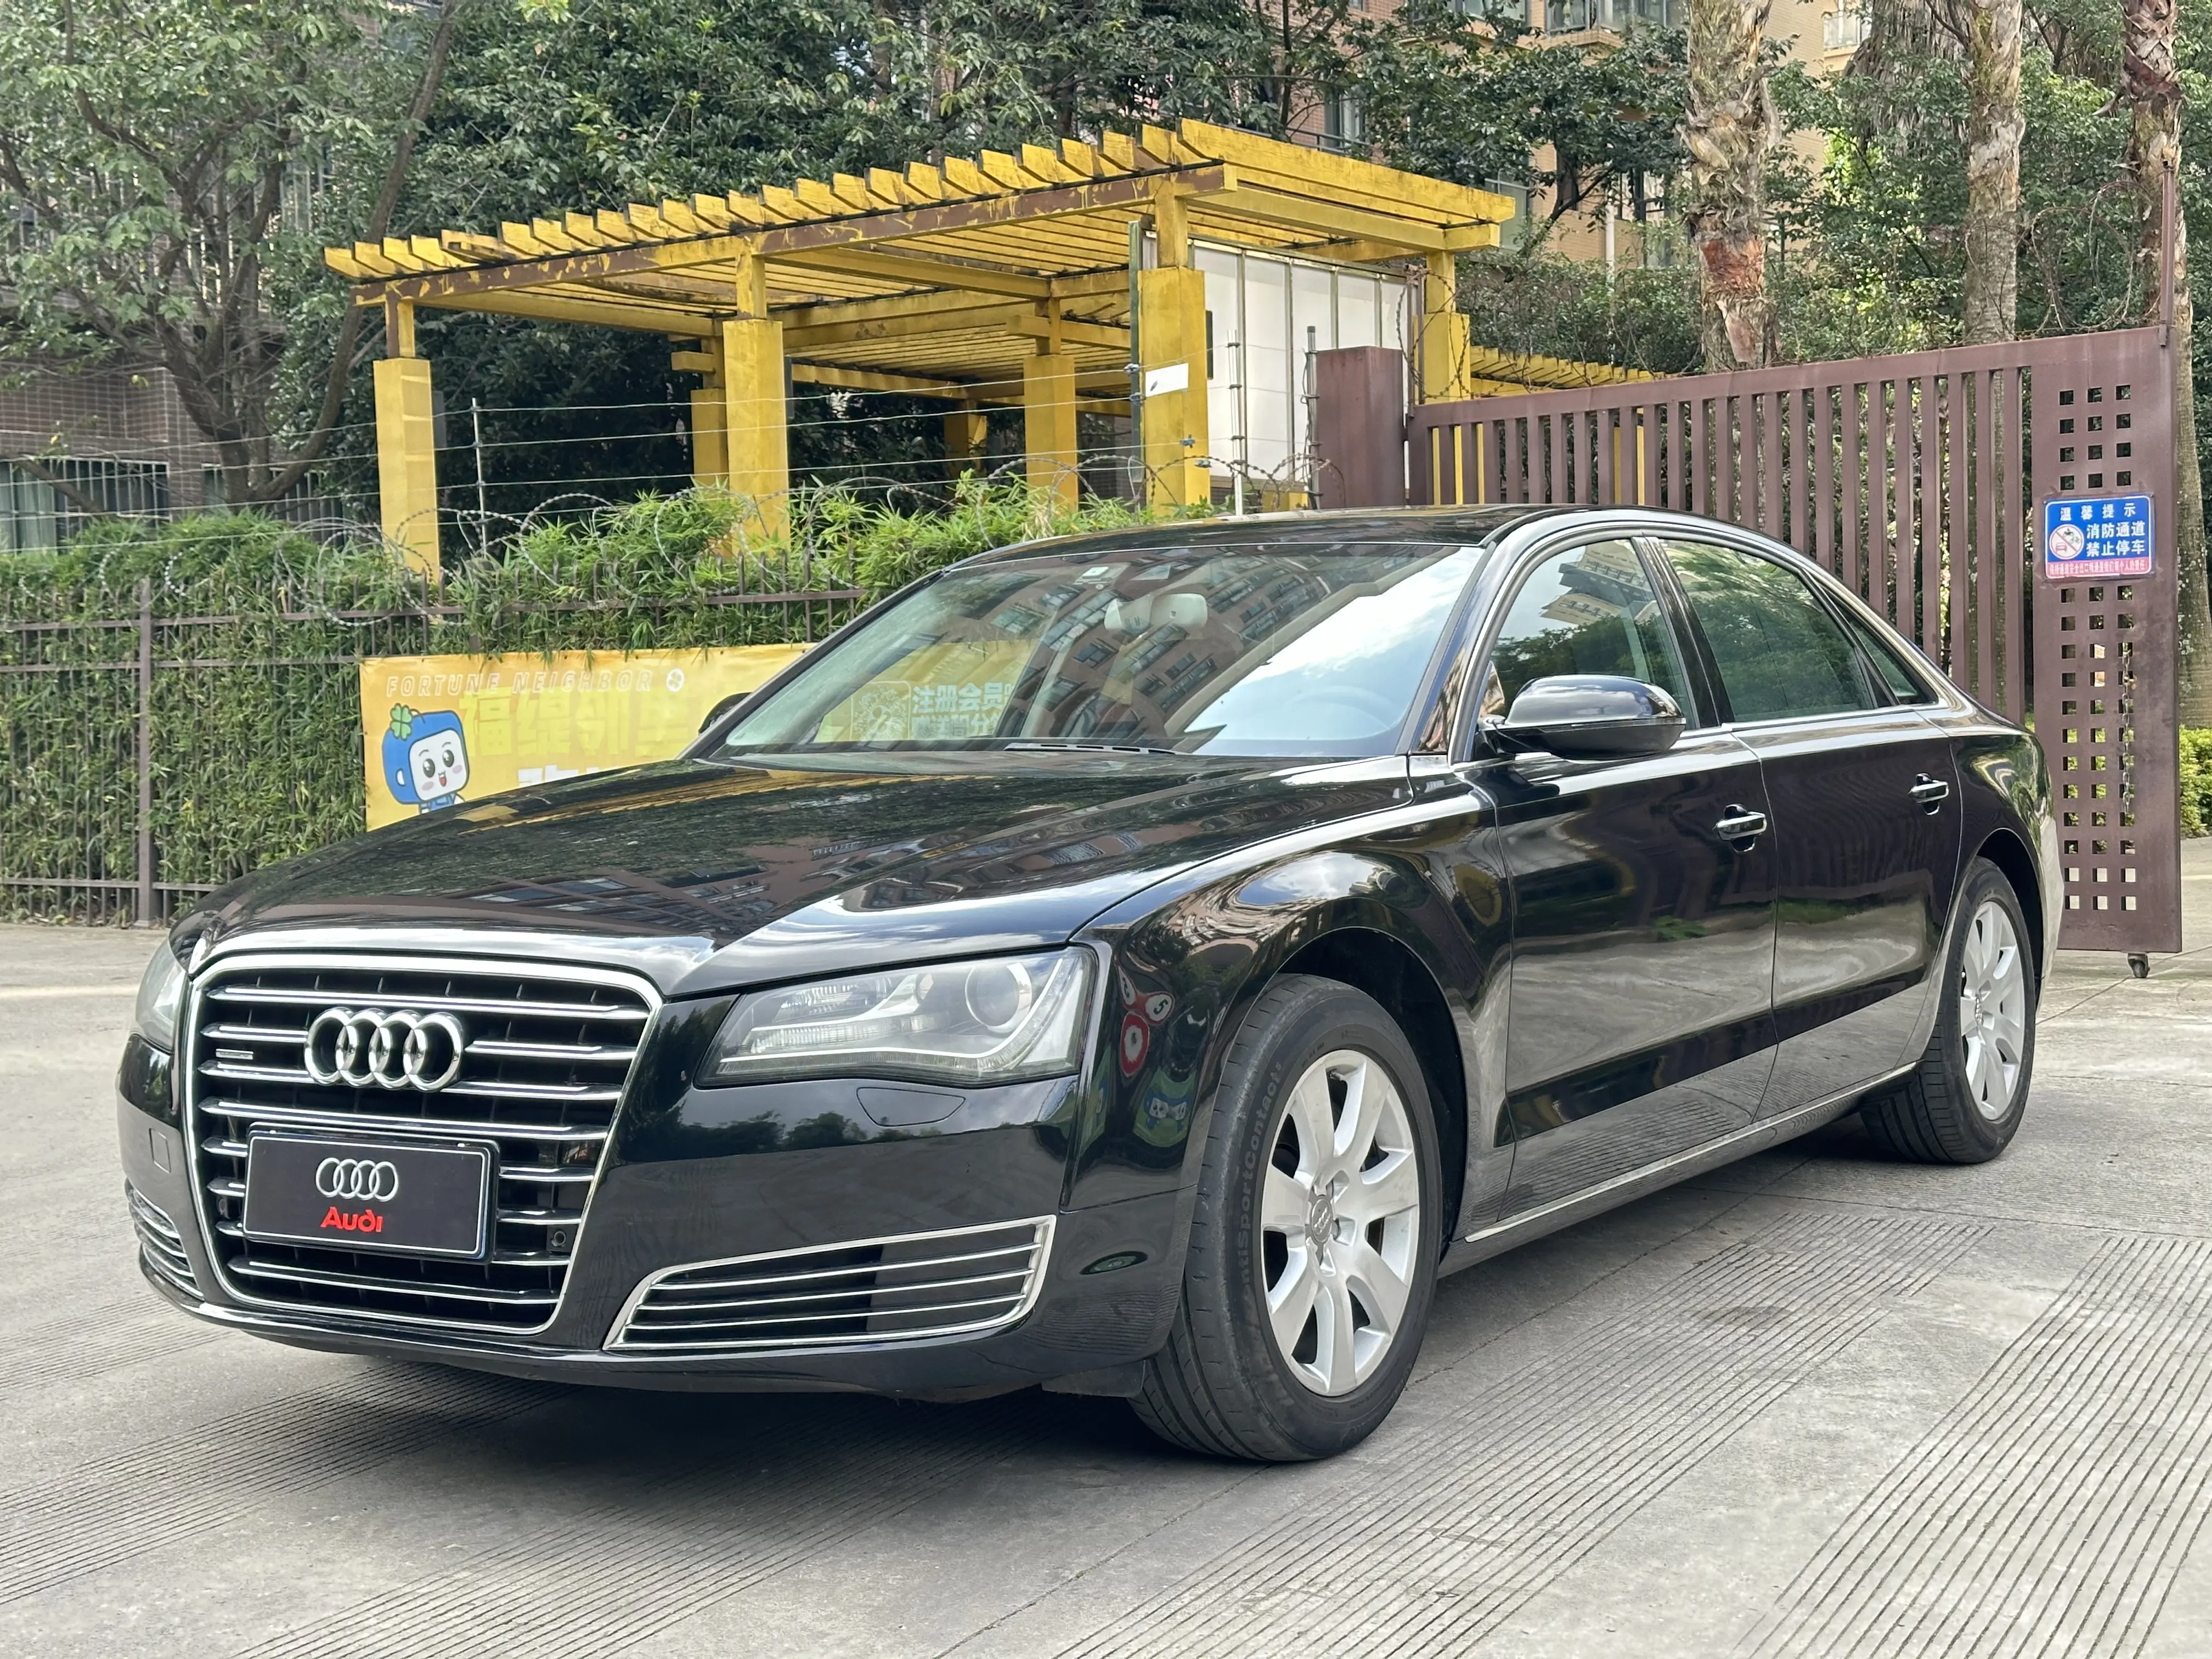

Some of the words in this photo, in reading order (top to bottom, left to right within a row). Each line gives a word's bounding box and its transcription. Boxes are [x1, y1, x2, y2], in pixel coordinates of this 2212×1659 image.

[2060, 503, 2136, 521] 温馨提示
[2086, 521, 2146, 539] 消防通道
[2086, 539, 2146, 557] 禁止停车
[386, 673, 500, 697] FORTUNE
[512, 669, 653, 695] NEIGHBOR
[1237, 1071, 1281, 1308] ontiSportContact
[320, 1206, 383, 1233] Audi
